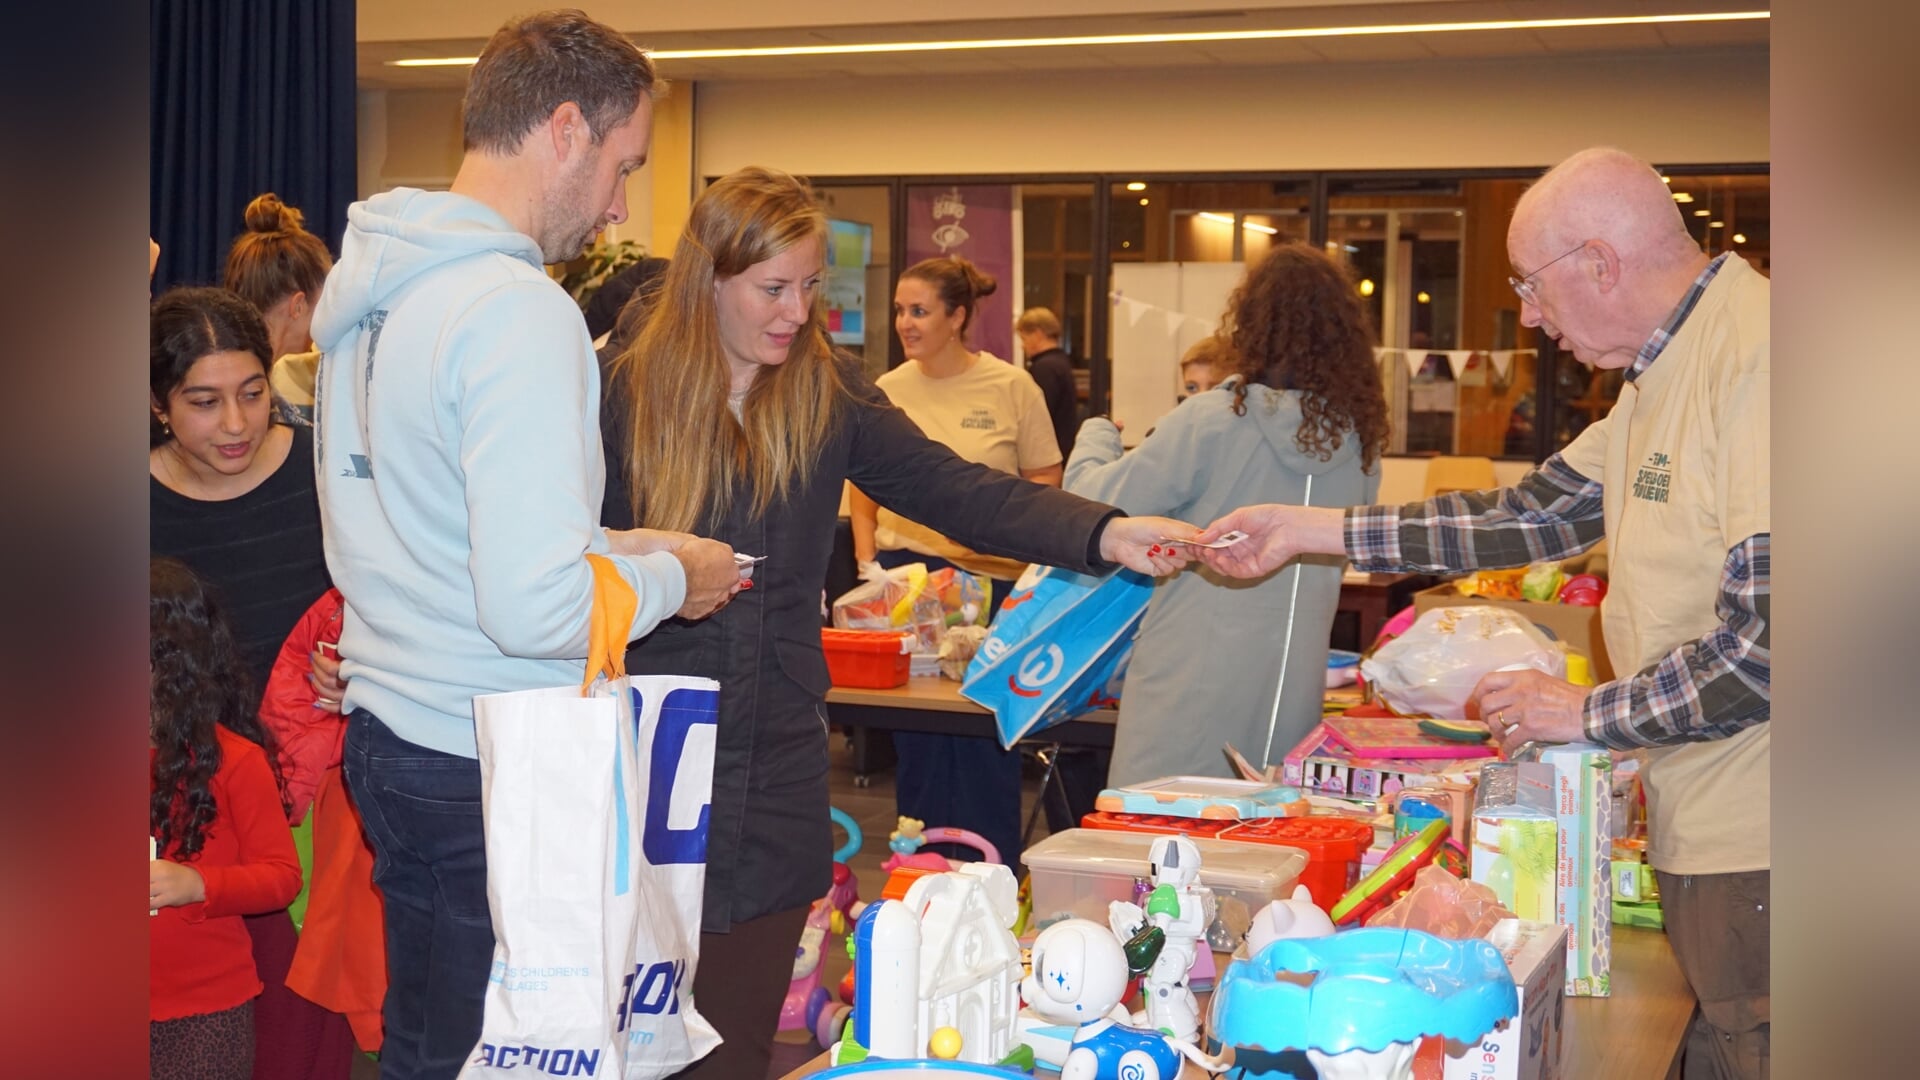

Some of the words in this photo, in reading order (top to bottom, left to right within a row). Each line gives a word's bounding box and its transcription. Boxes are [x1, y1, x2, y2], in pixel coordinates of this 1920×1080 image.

[1560, 795, 1568, 815] Parco
[520, 966, 590, 978] CHILDREN'S
[473, 1043, 601, 1077] ACTION
